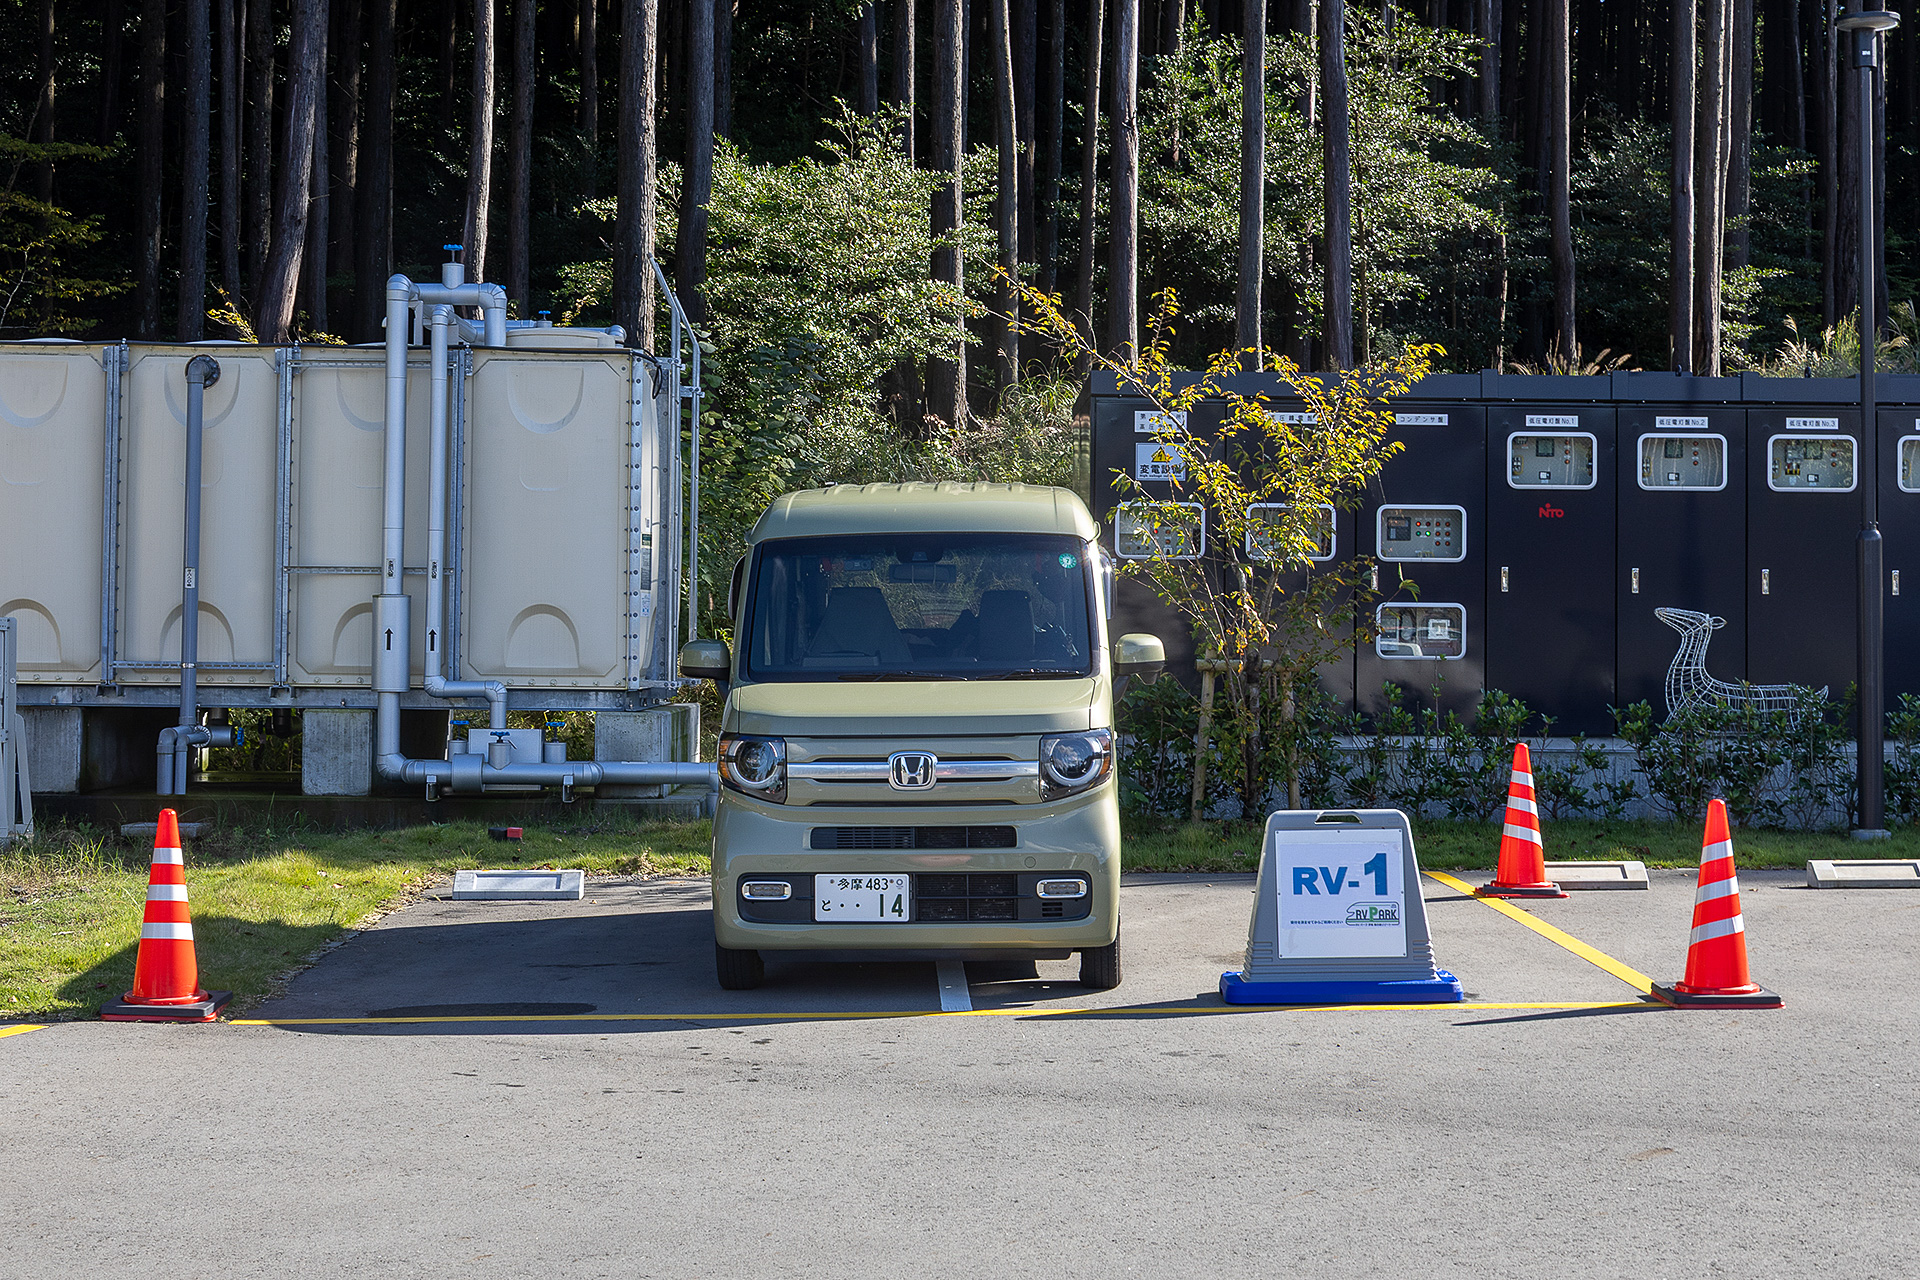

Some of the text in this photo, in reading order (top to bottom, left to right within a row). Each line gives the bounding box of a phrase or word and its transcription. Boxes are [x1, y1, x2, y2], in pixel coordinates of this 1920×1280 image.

[837, 877, 889, 891] 多摩 483
[1292, 852, 1388, 896] RV-1
[821, 893, 904, 918] と 14
